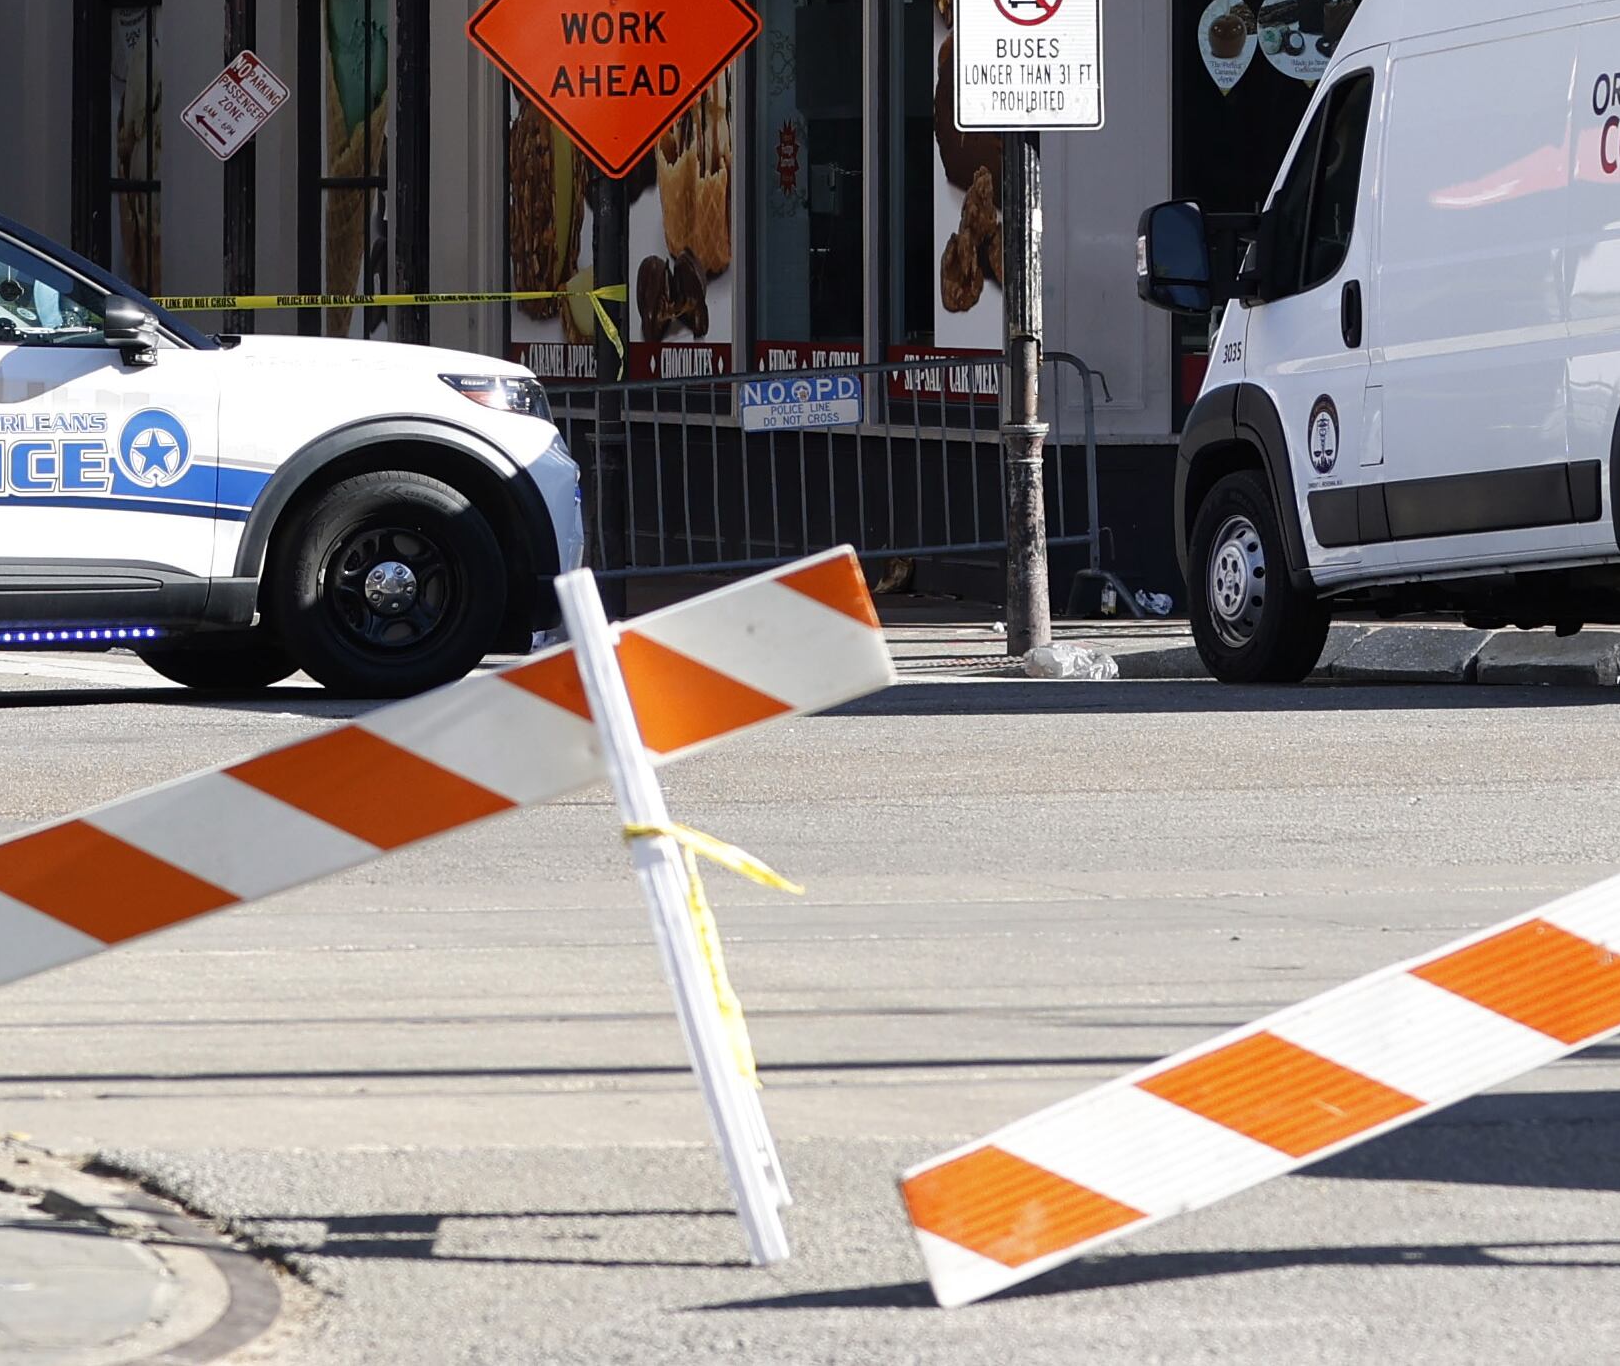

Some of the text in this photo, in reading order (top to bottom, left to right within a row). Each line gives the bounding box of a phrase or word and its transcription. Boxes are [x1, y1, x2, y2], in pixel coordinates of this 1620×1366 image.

[561, 12, 668, 46] WORK
[996, 38, 1060, 59] BUSES
[233, 56, 282, 106] NO PARKING
[549, 64, 682, 98] AHEAD
[964, 64, 1093, 86] LONGER THAN 31 FT
[218, 76, 266, 122] PASSENGER
[218, 96, 245, 123] ZONE
[991, 90, 1065, 111] PROHIBITED
[165, 298, 181, 308] LINE
[182, 298, 193, 308] DO
[194, 297, 210, 308] NOT
[211, 297, 237, 307] CROSS
[276, 296, 303, 306] POLICE
[304, 295, 319, 306] LINE
[333, 295, 347, 305] NOT
[349, 295, 375, 304] CROSS
[530, 343, 565, 378] CARAMEL
[660, 347, 713, 379] CHOCOLATES
[1222, 340, 1242, 364] 3035
[949, 355, 1000, 395] CARMELS
[763, 413, 840, 427] DO NOT CROSS
[770, 402, 831, 414] POLICE LINE
